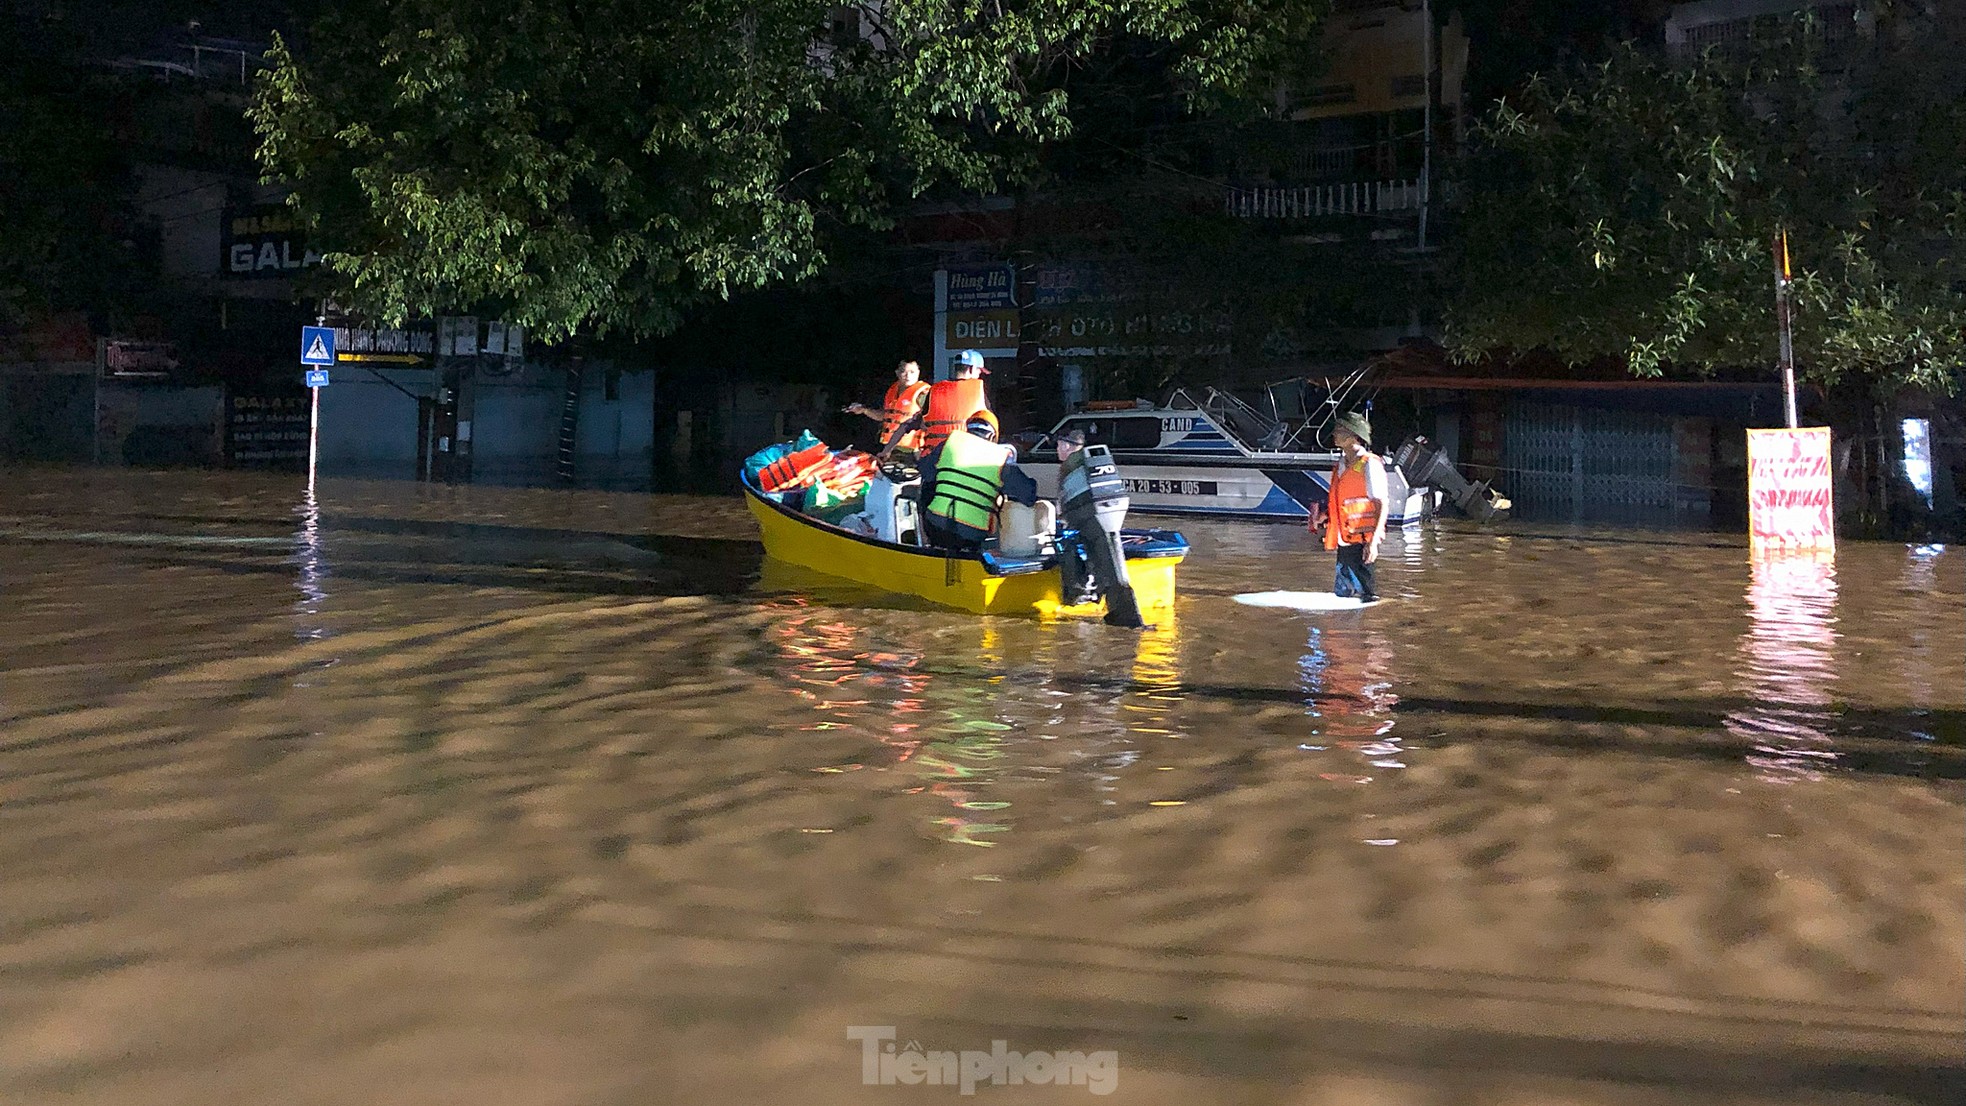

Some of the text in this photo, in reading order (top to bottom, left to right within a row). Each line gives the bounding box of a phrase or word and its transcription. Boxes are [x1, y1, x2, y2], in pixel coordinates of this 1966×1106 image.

[950, 270, 1007, 292] Hùng Hà
[1161, 418, 1192, 432] CAND
[1091, 465, 1116, 476] 70
